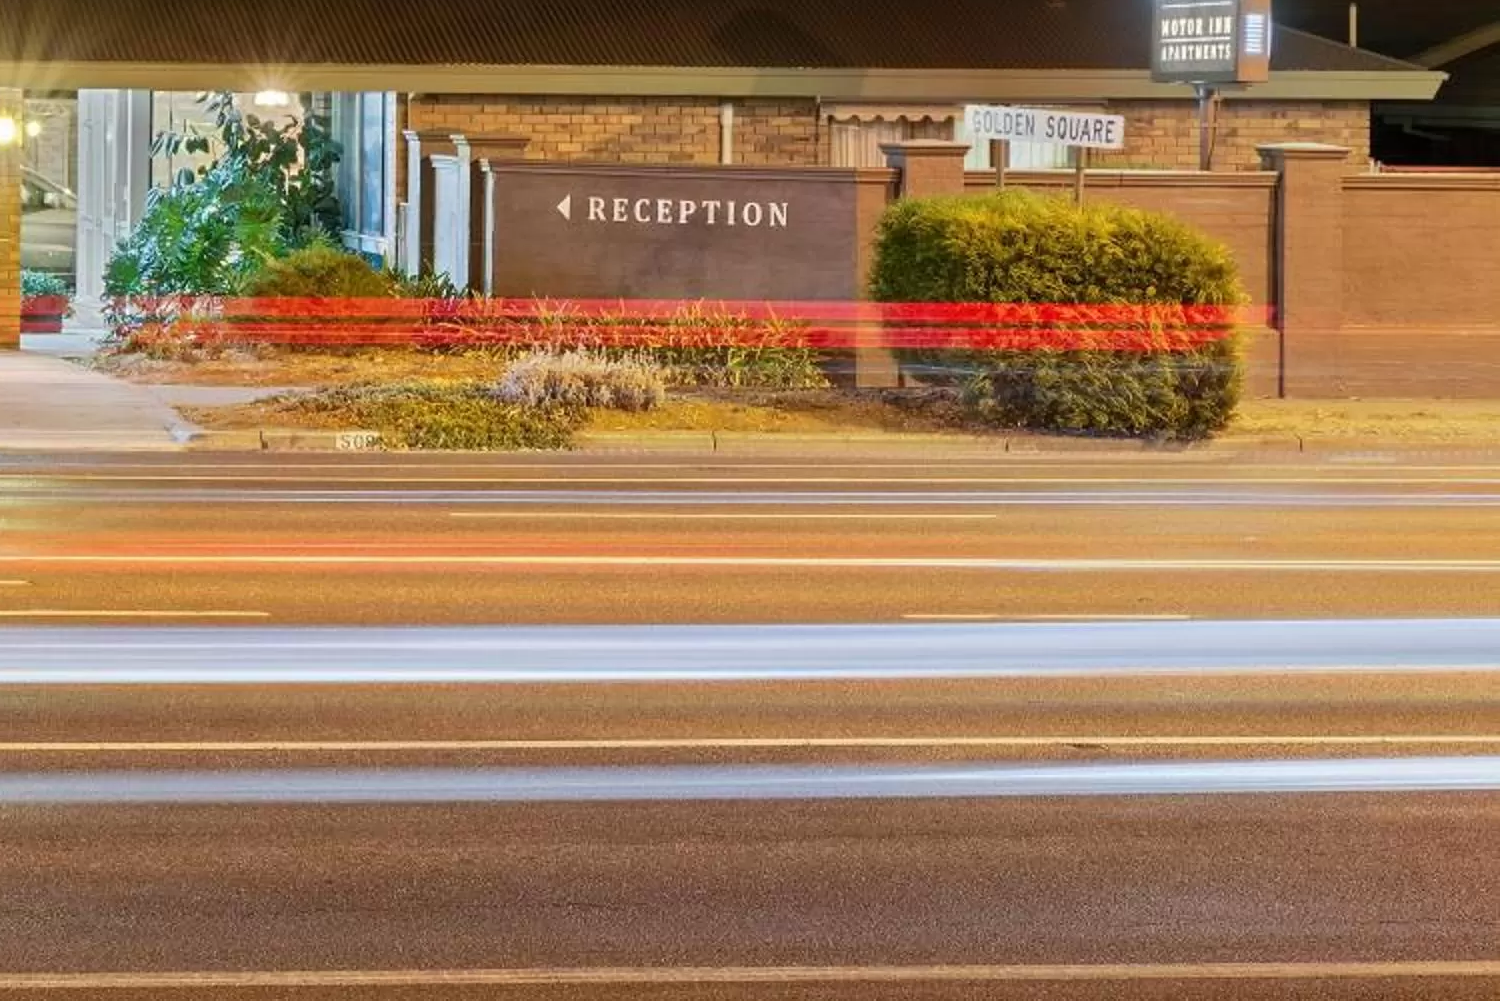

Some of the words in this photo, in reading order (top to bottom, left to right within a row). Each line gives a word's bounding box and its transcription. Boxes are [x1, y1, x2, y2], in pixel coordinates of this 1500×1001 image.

[1161, 18, 1203, 37] MOTOR
[1209, 16, 1232, 34] INN
[1161, 43, 1232, 61] APARTMENTS
[972, 110, 1036, 136] GOLDEN
[1045, 115, 1115, 143] SQUARE
[587, 196, 789, 227] RECEPTION
